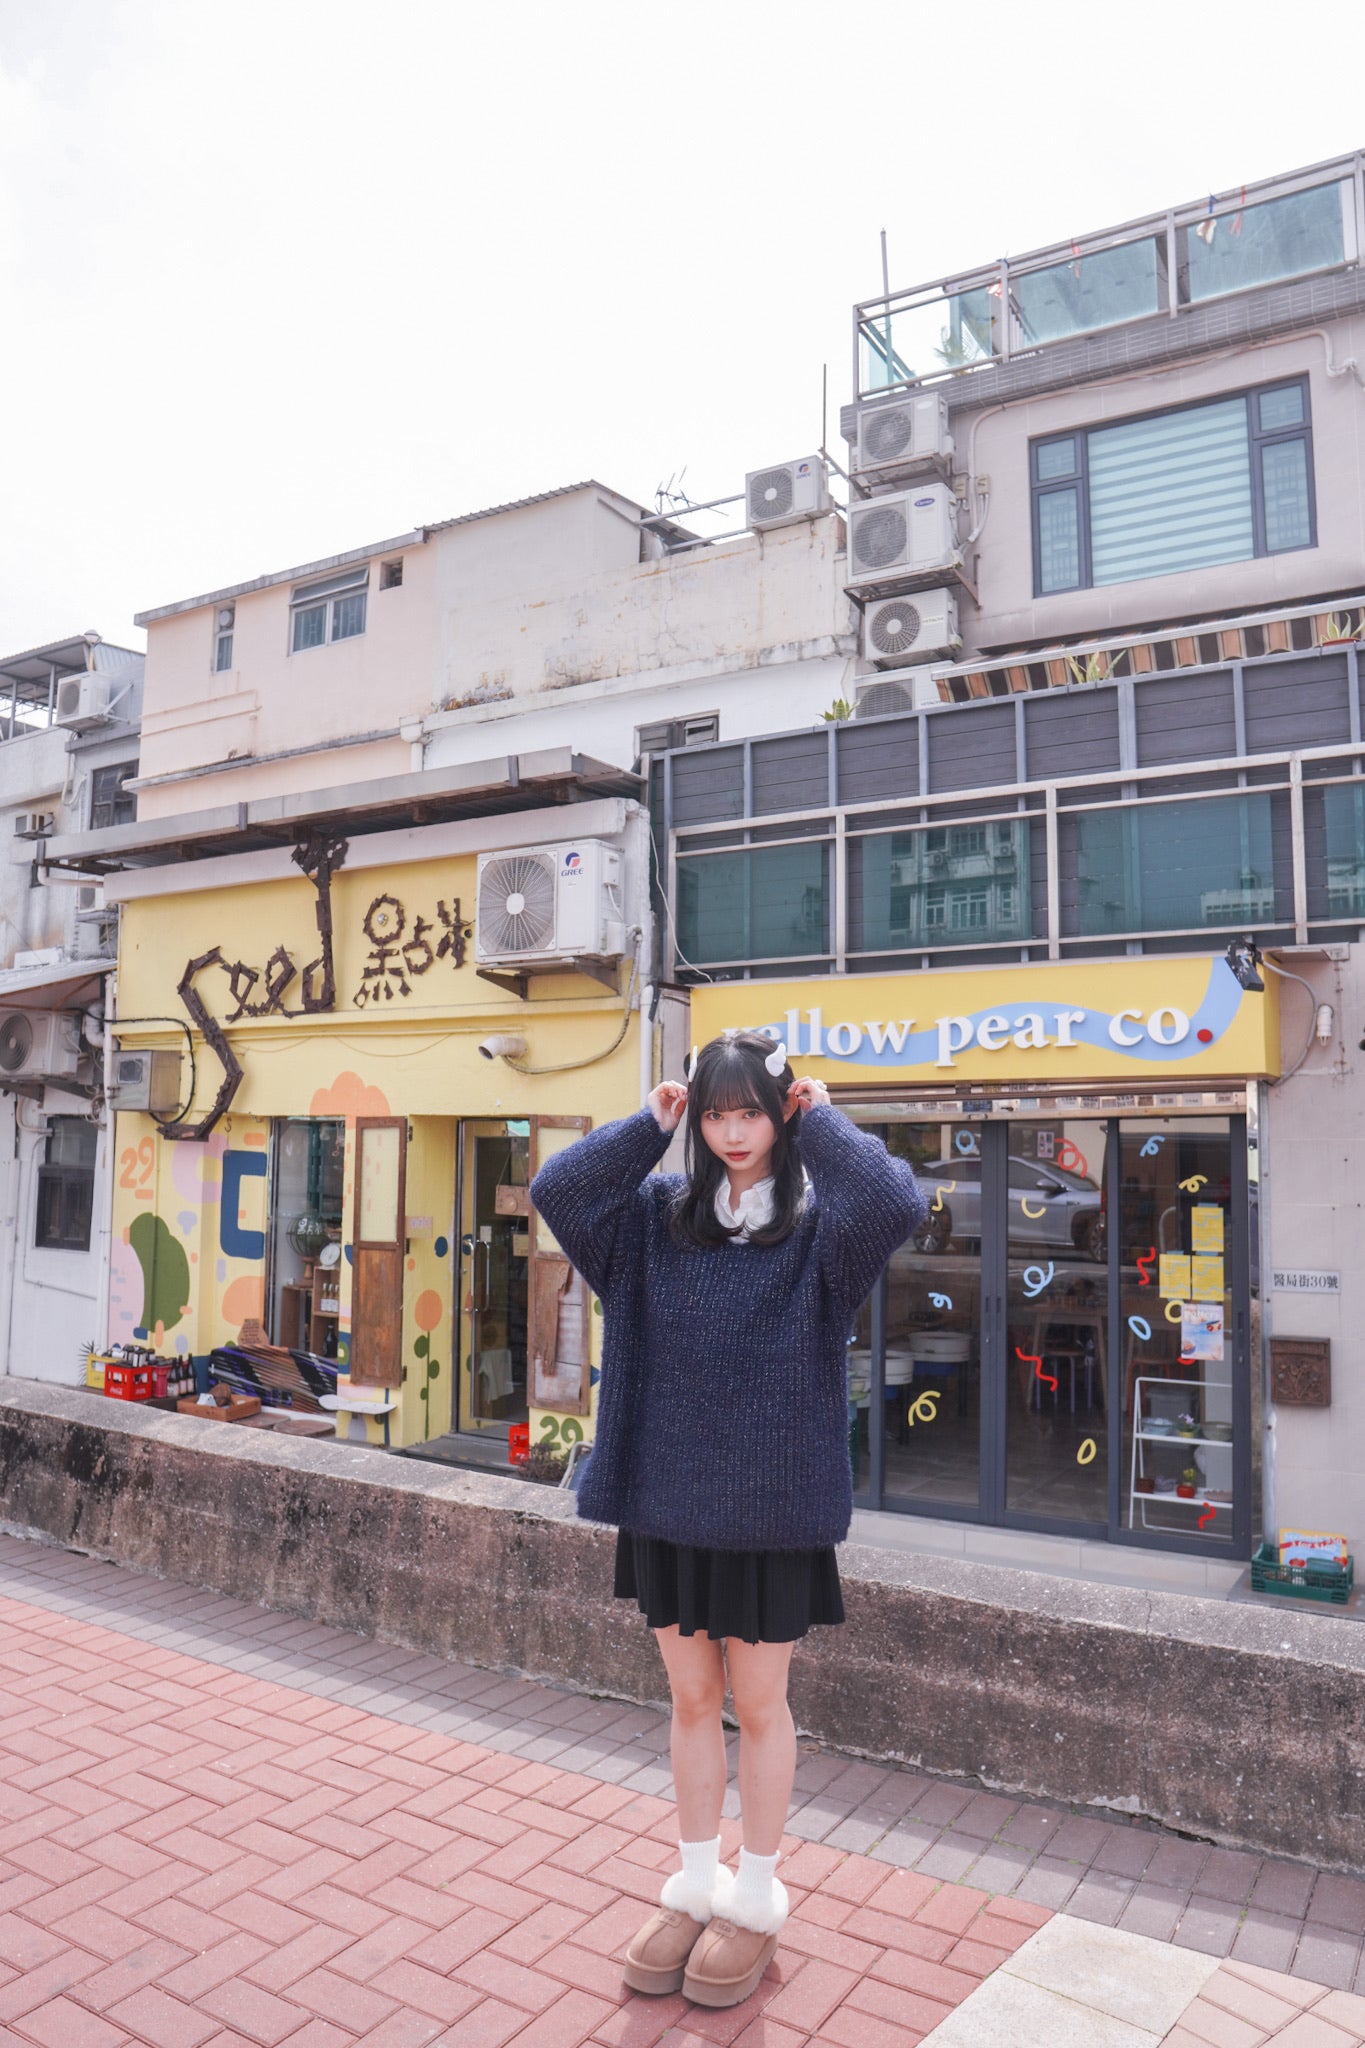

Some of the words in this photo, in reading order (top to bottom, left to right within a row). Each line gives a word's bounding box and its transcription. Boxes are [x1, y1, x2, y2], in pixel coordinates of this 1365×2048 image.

[561, 868, 584, 877] GREE
[935, 1009, 1086, 1068] pear
[1108, 1007, 1214, 1047] co.
[119, 1135, 155, 1189] 29
[539, 1415, 584, 1451] 29
